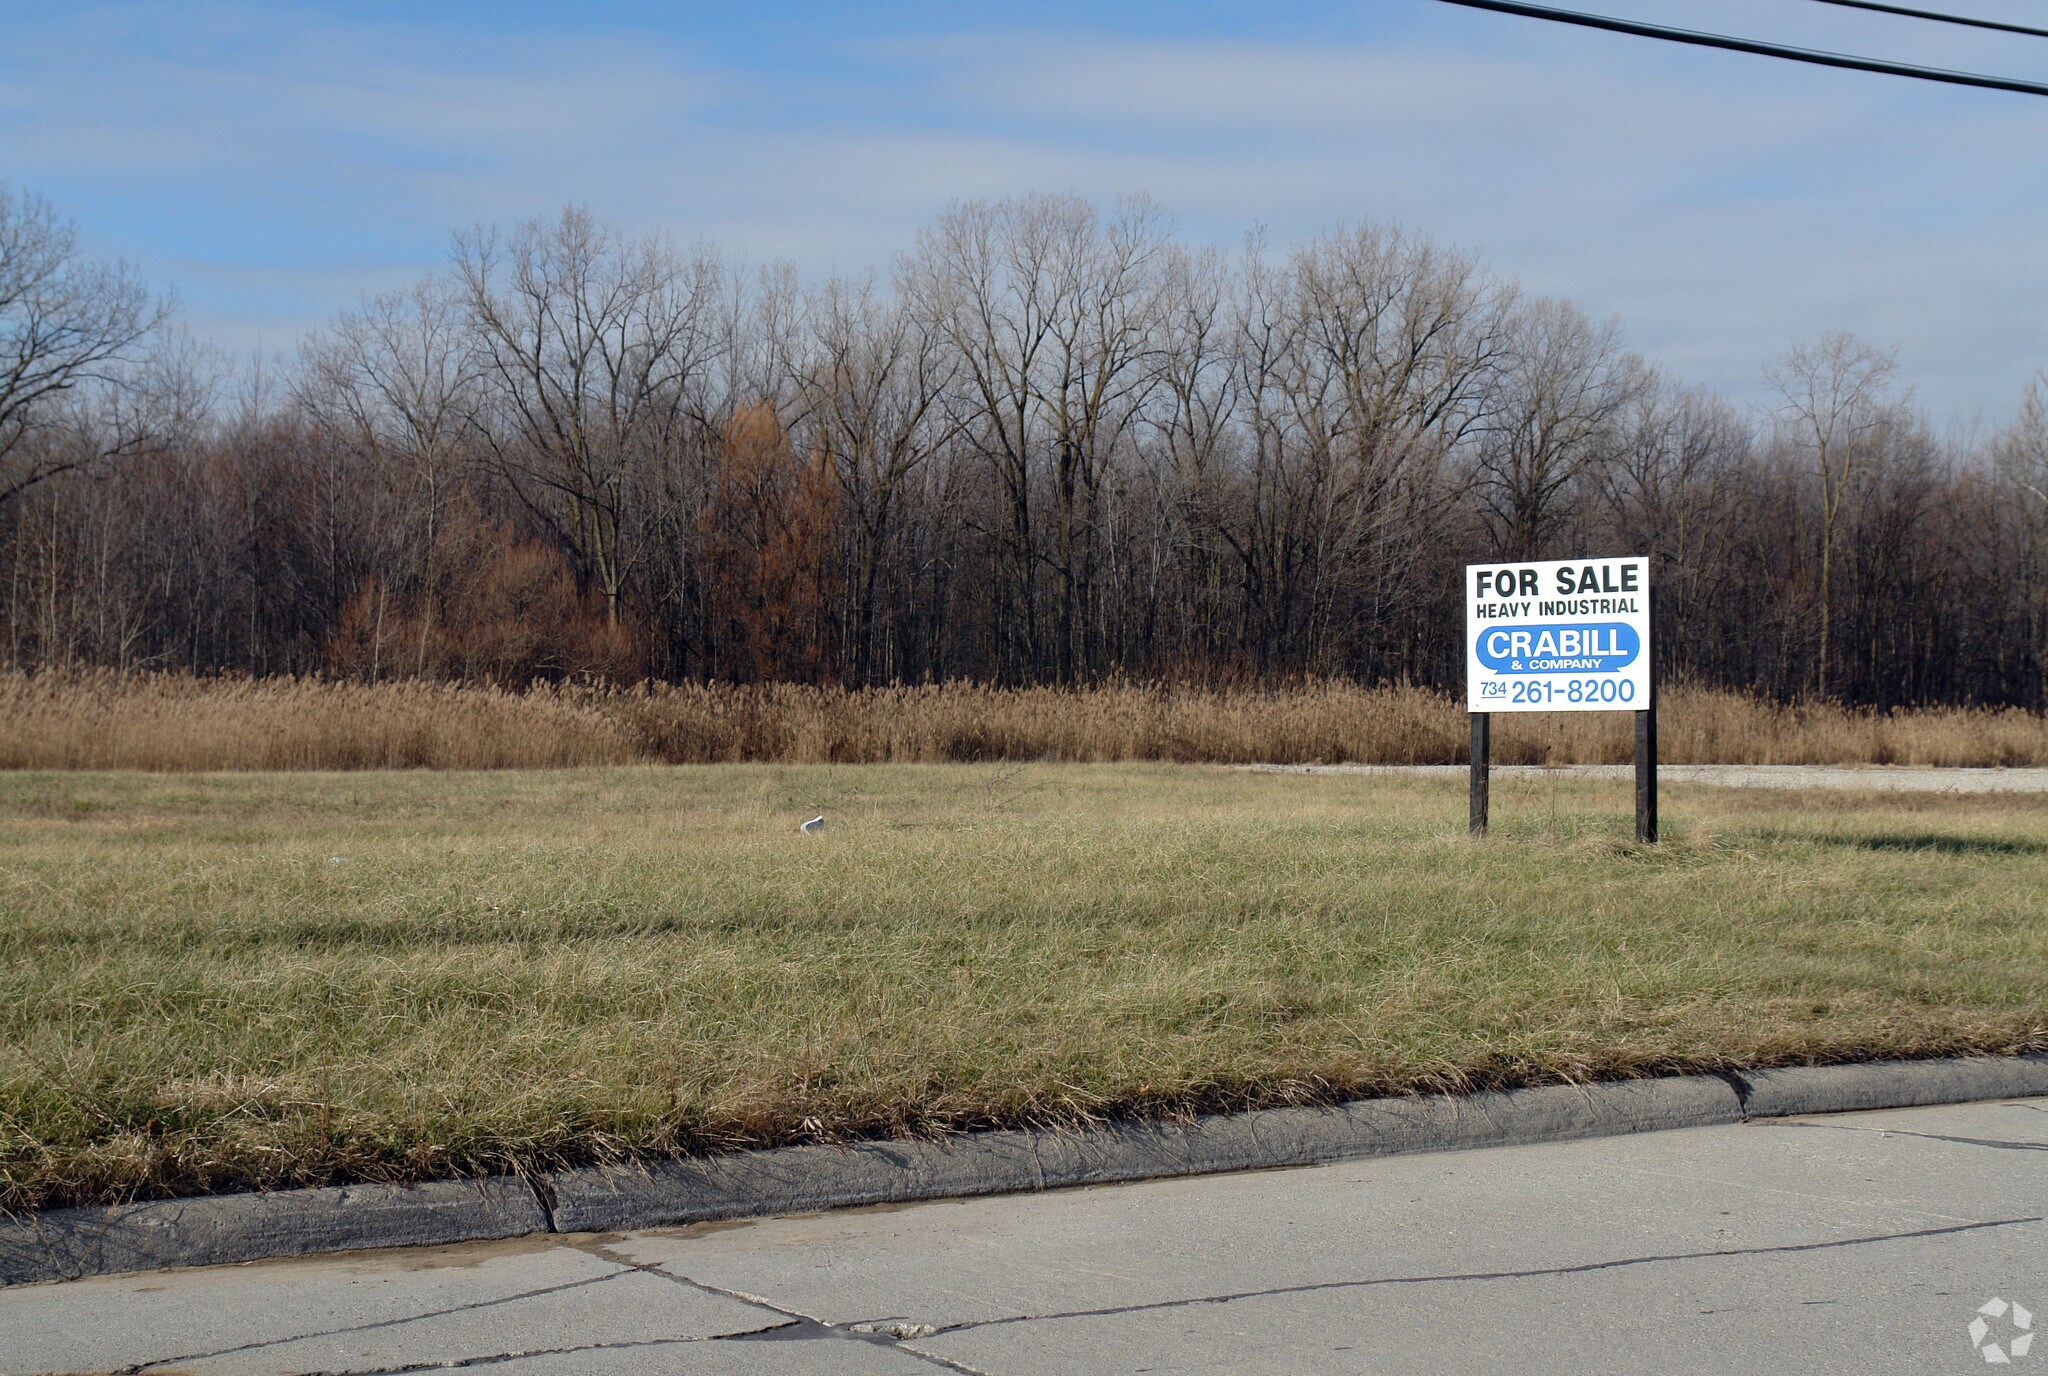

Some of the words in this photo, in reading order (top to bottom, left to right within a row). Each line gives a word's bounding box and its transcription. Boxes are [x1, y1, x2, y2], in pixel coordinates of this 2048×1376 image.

[1476, 569, 1539, 598] FOR
[1556, 564, 1639, 595] SALE
[1477, 602, 1531, 618] HEAVY
[1539, 598, 1639, 616] INDUSTRIAL
[1486, 628, 1628, 659] CRABILL
[1511, 660, 1523, 670] &
[1529, 658, 1603, 670] COMPANY
[1480, 681, 1507, 696] 734
[1512, 679, 1635, 703] 261-8200
